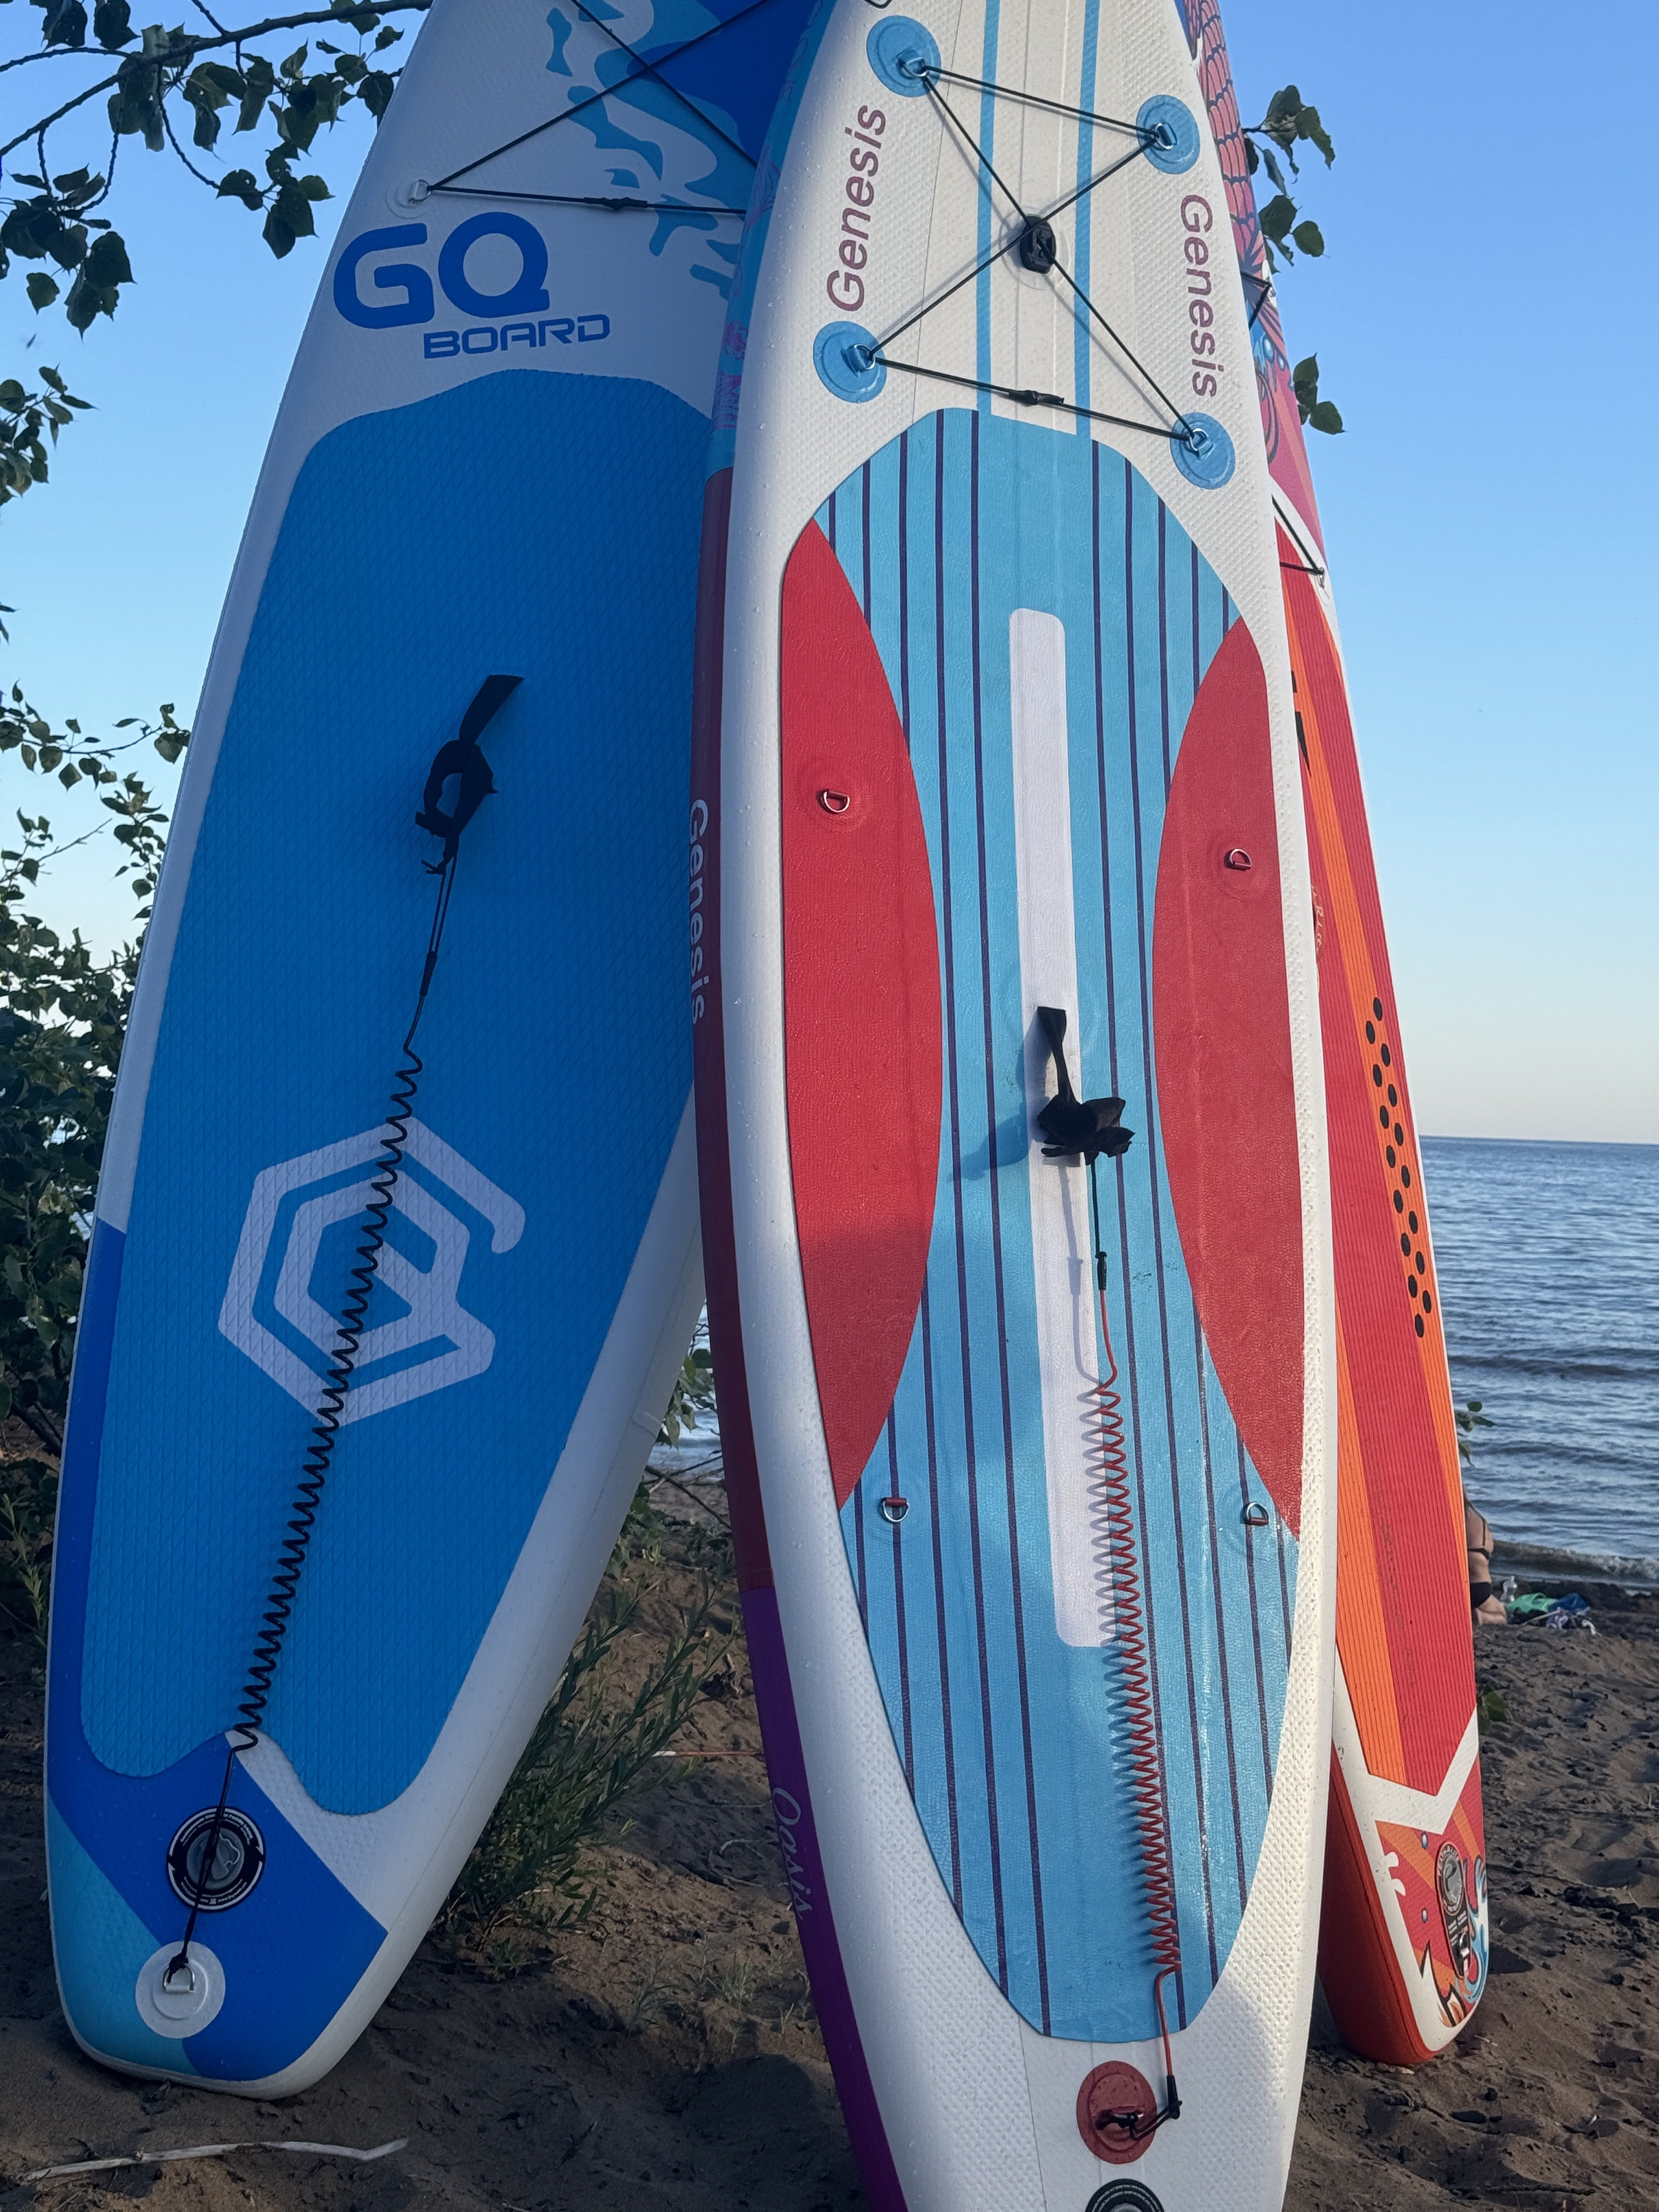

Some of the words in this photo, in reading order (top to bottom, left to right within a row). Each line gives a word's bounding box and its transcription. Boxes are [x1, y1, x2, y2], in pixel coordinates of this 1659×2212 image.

[333, 211, 550, 329] GQ
[826, 104, 887, 312] Genesis
[424, 313, 610, 359] BOARD
[1180, 194, 1224, 398] Genesis
[689, 799, 709, 1025] Genesis
[772, 1787, 812, 1920] Oasis
